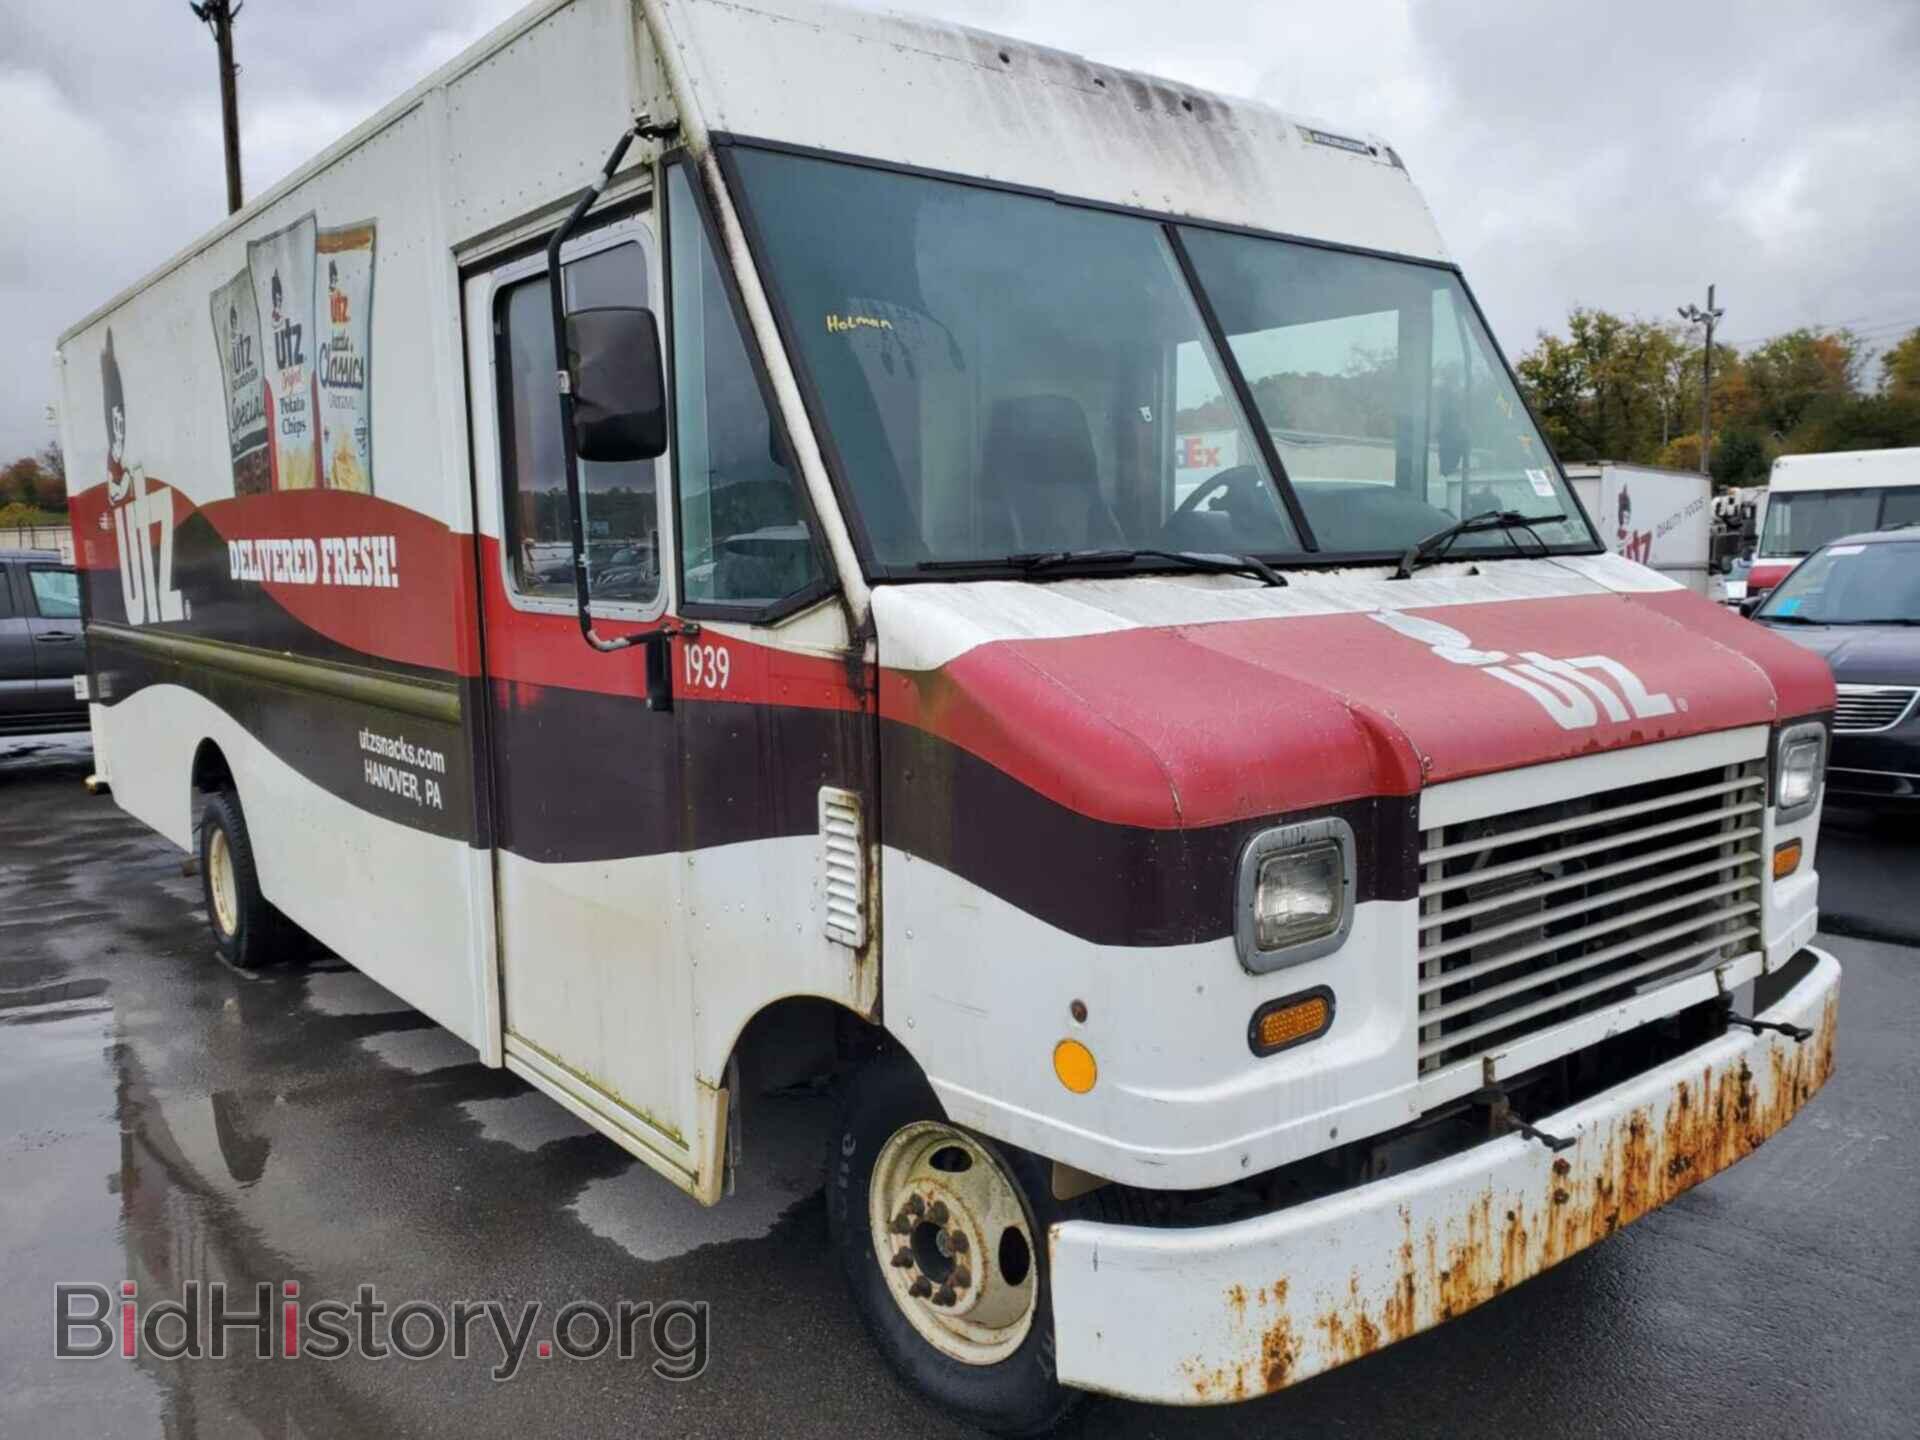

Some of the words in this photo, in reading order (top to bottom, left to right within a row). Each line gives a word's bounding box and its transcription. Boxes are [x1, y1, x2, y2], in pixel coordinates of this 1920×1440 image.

[227, 538, 318, 585] DELIVERED
[320, 535, 399, 588] FRESH!
[683, 644, 730, 689] 1939
[358, 727, 446, 774] utzsnacks.com
[364, 758, 422, 807] HANOVER,
[425, 779, 442, 810] PA
